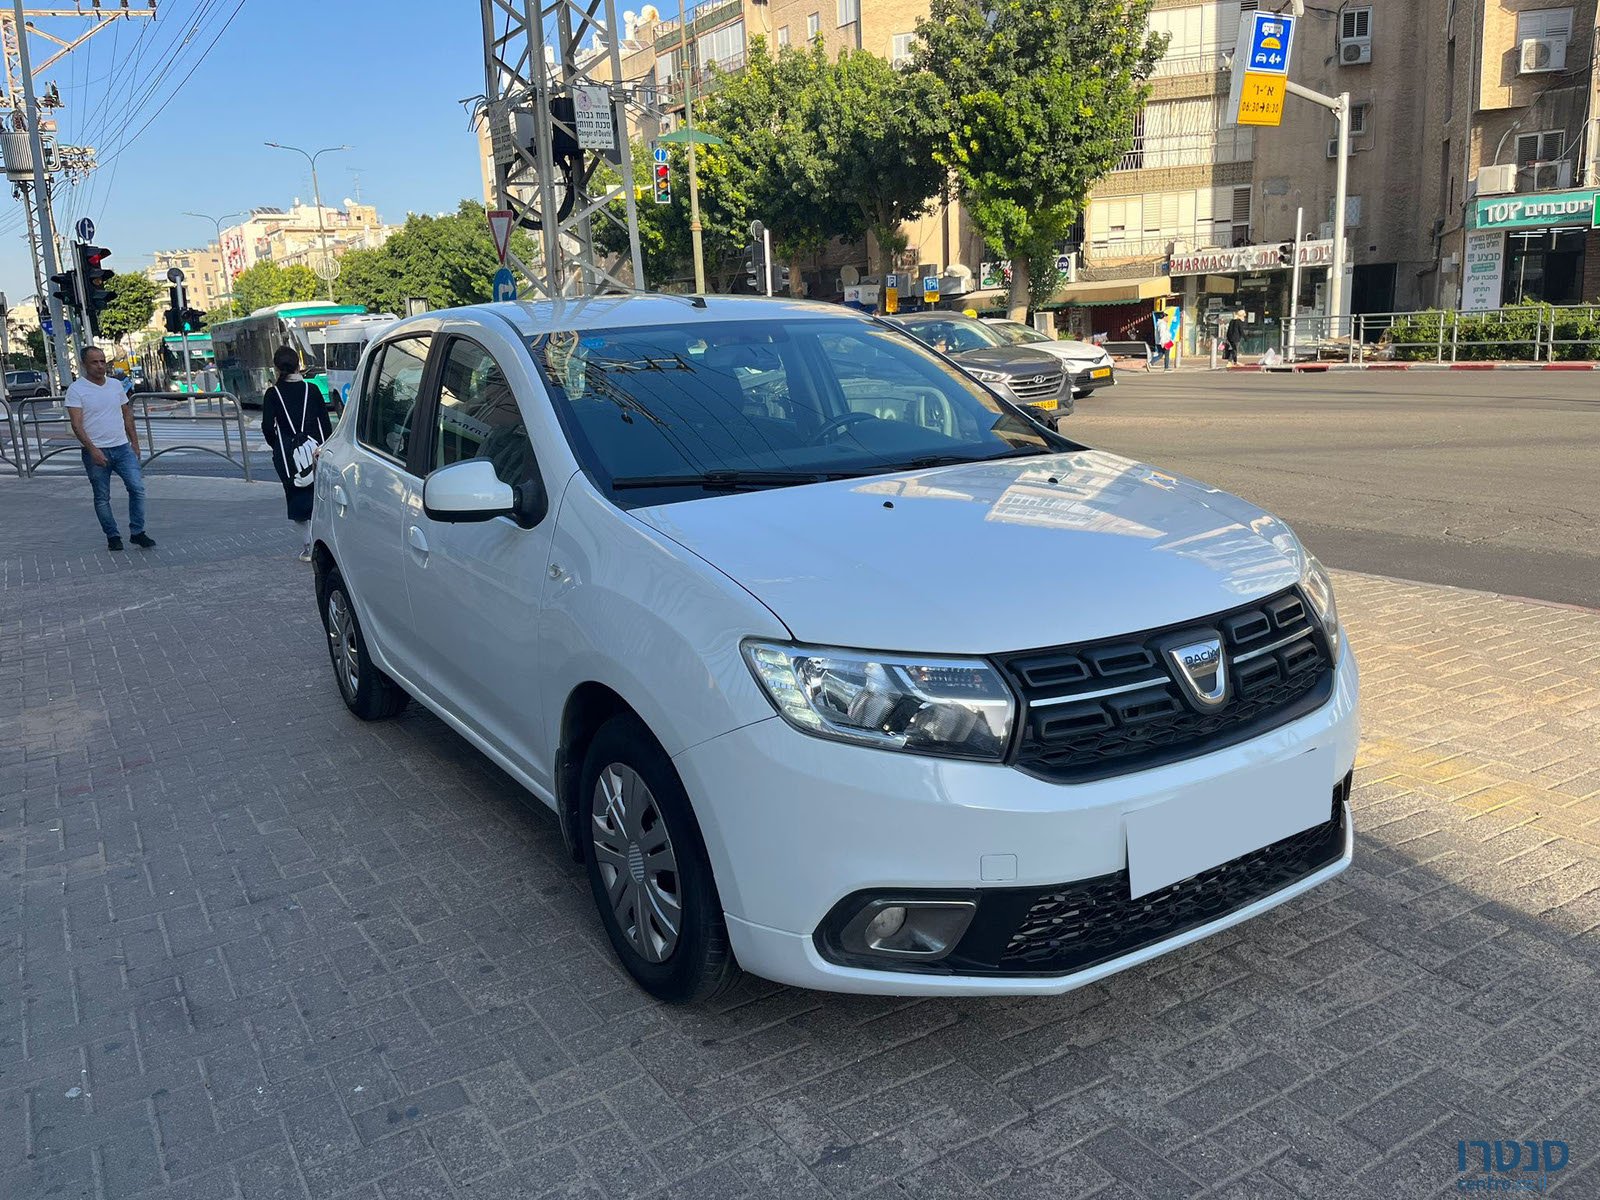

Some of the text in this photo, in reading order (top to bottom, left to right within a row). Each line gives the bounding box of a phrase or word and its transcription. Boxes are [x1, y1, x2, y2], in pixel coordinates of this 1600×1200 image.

[1268, 52, 1282, 65] 4+
[595, 111, 610, 120] מתח
[595, 121, 611, 129] סכנת
[1485, 201, 1523, 223] TOP
[1170, 253, 1235, 272] PHARMACY
[1477, 253, 1500, 262] מבצע
[1185, 648, 1219, 664] DACIA
